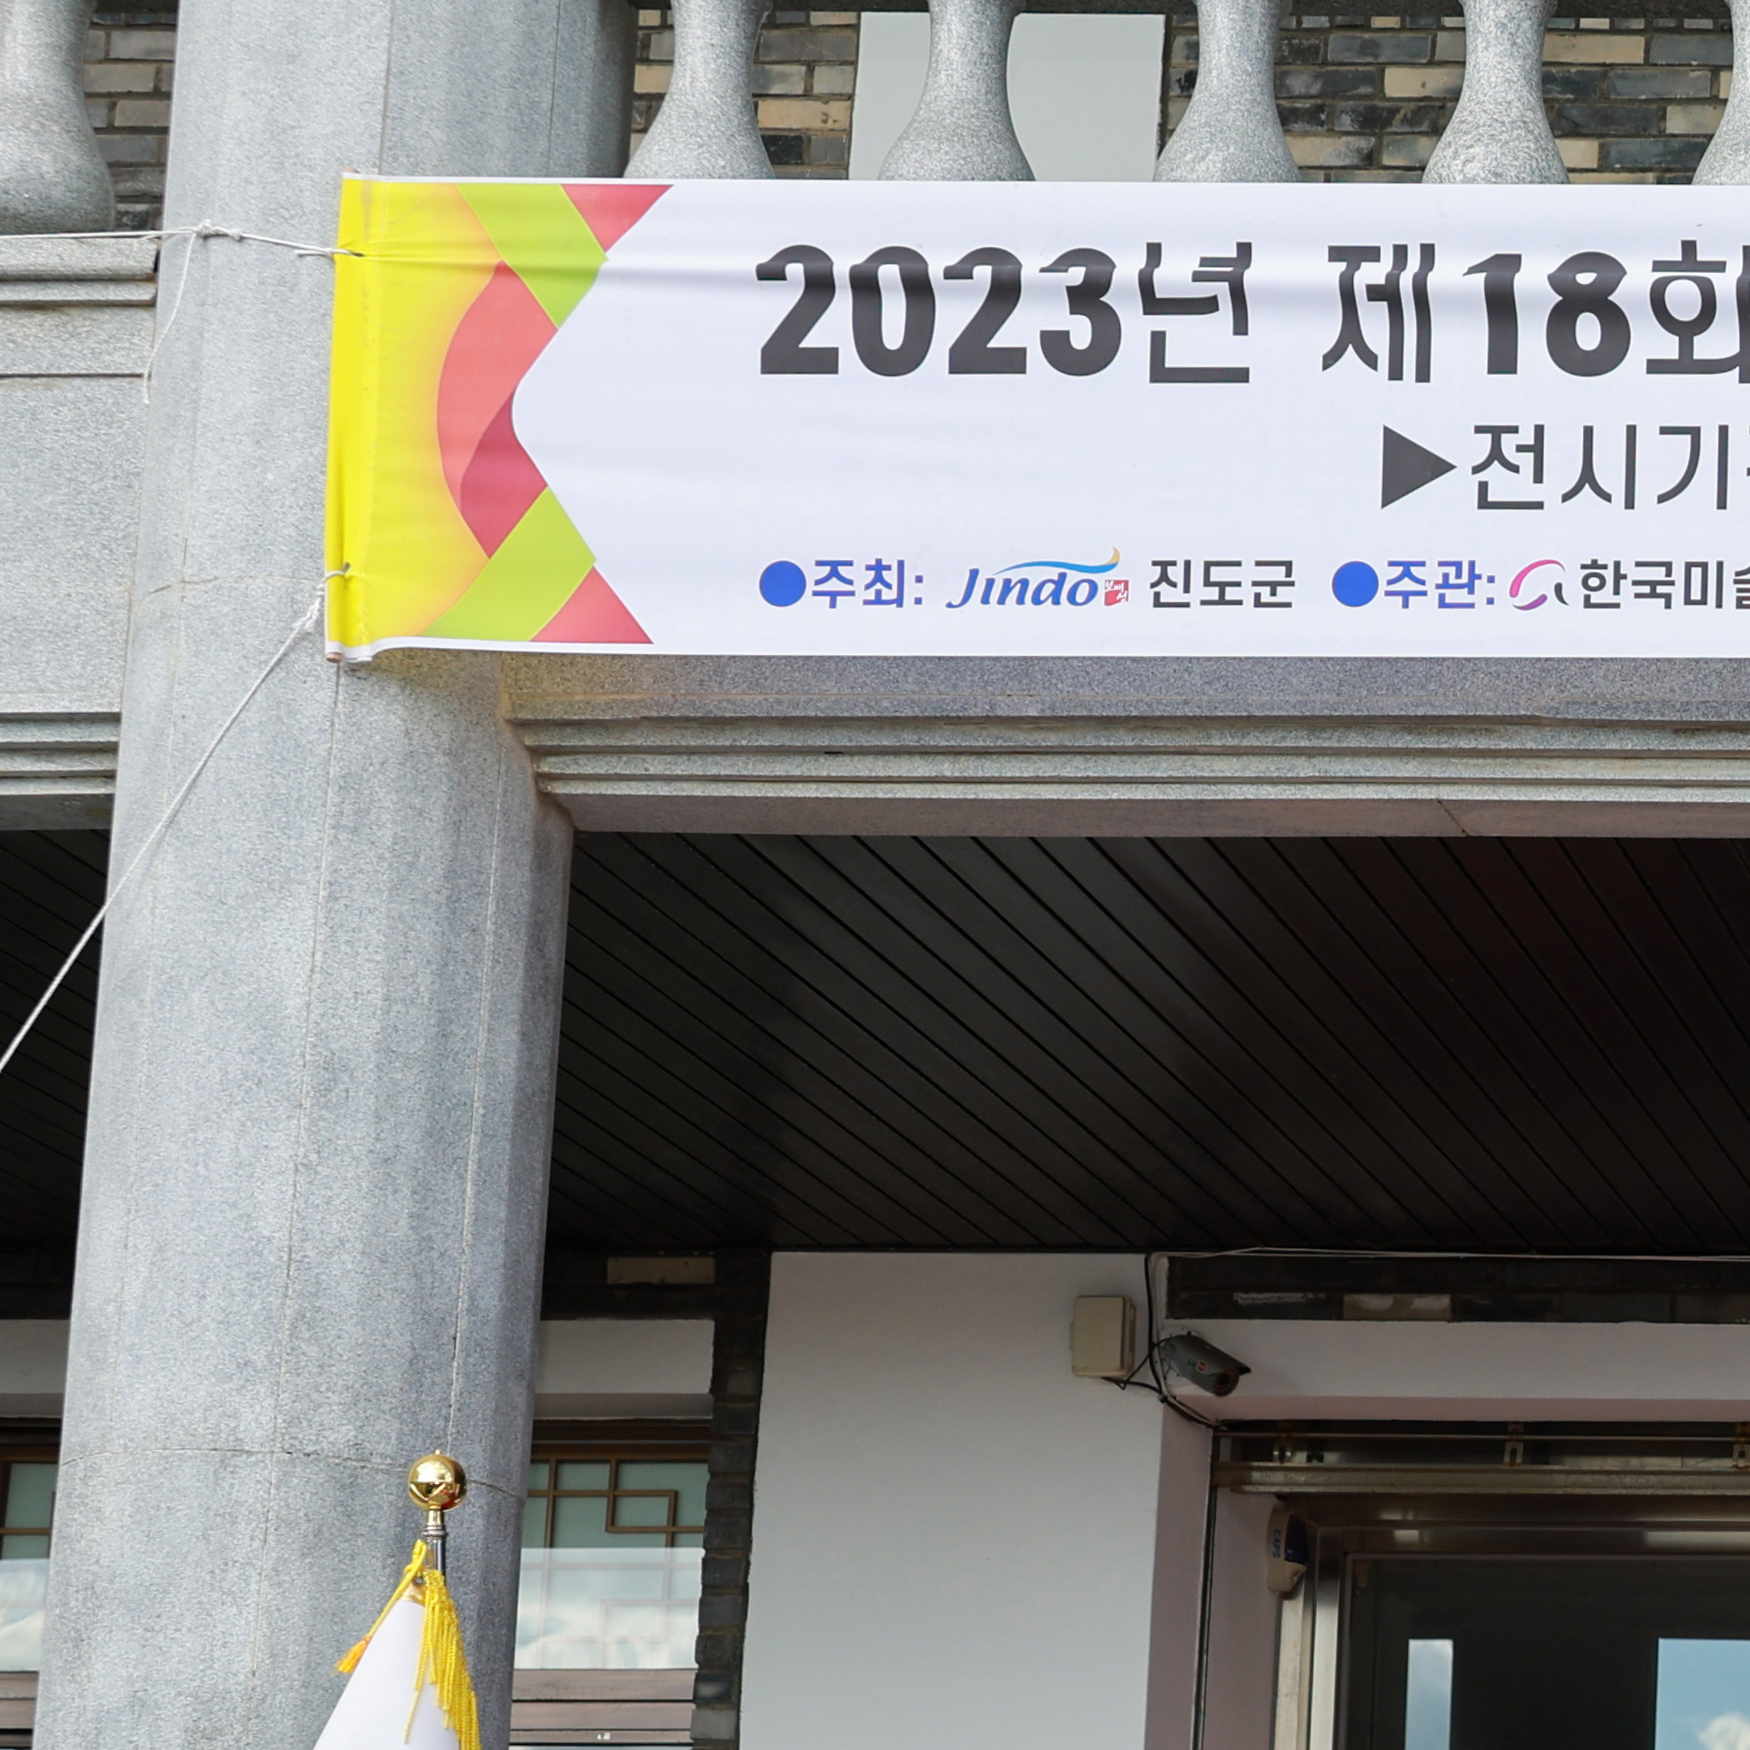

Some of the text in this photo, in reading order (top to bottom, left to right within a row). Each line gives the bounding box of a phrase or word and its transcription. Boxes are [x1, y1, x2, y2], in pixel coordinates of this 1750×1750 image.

[757, 243, 1253, 384] 2023년
[812, 559, 924, 609] 주최:
[945, 567, 1099, 609] Jindo
[1151, 561, 1296, 609] 진도군
[1385, 561, 1496, 610] 주관:
[1272, 1529, 1282, 1559] CAPS
